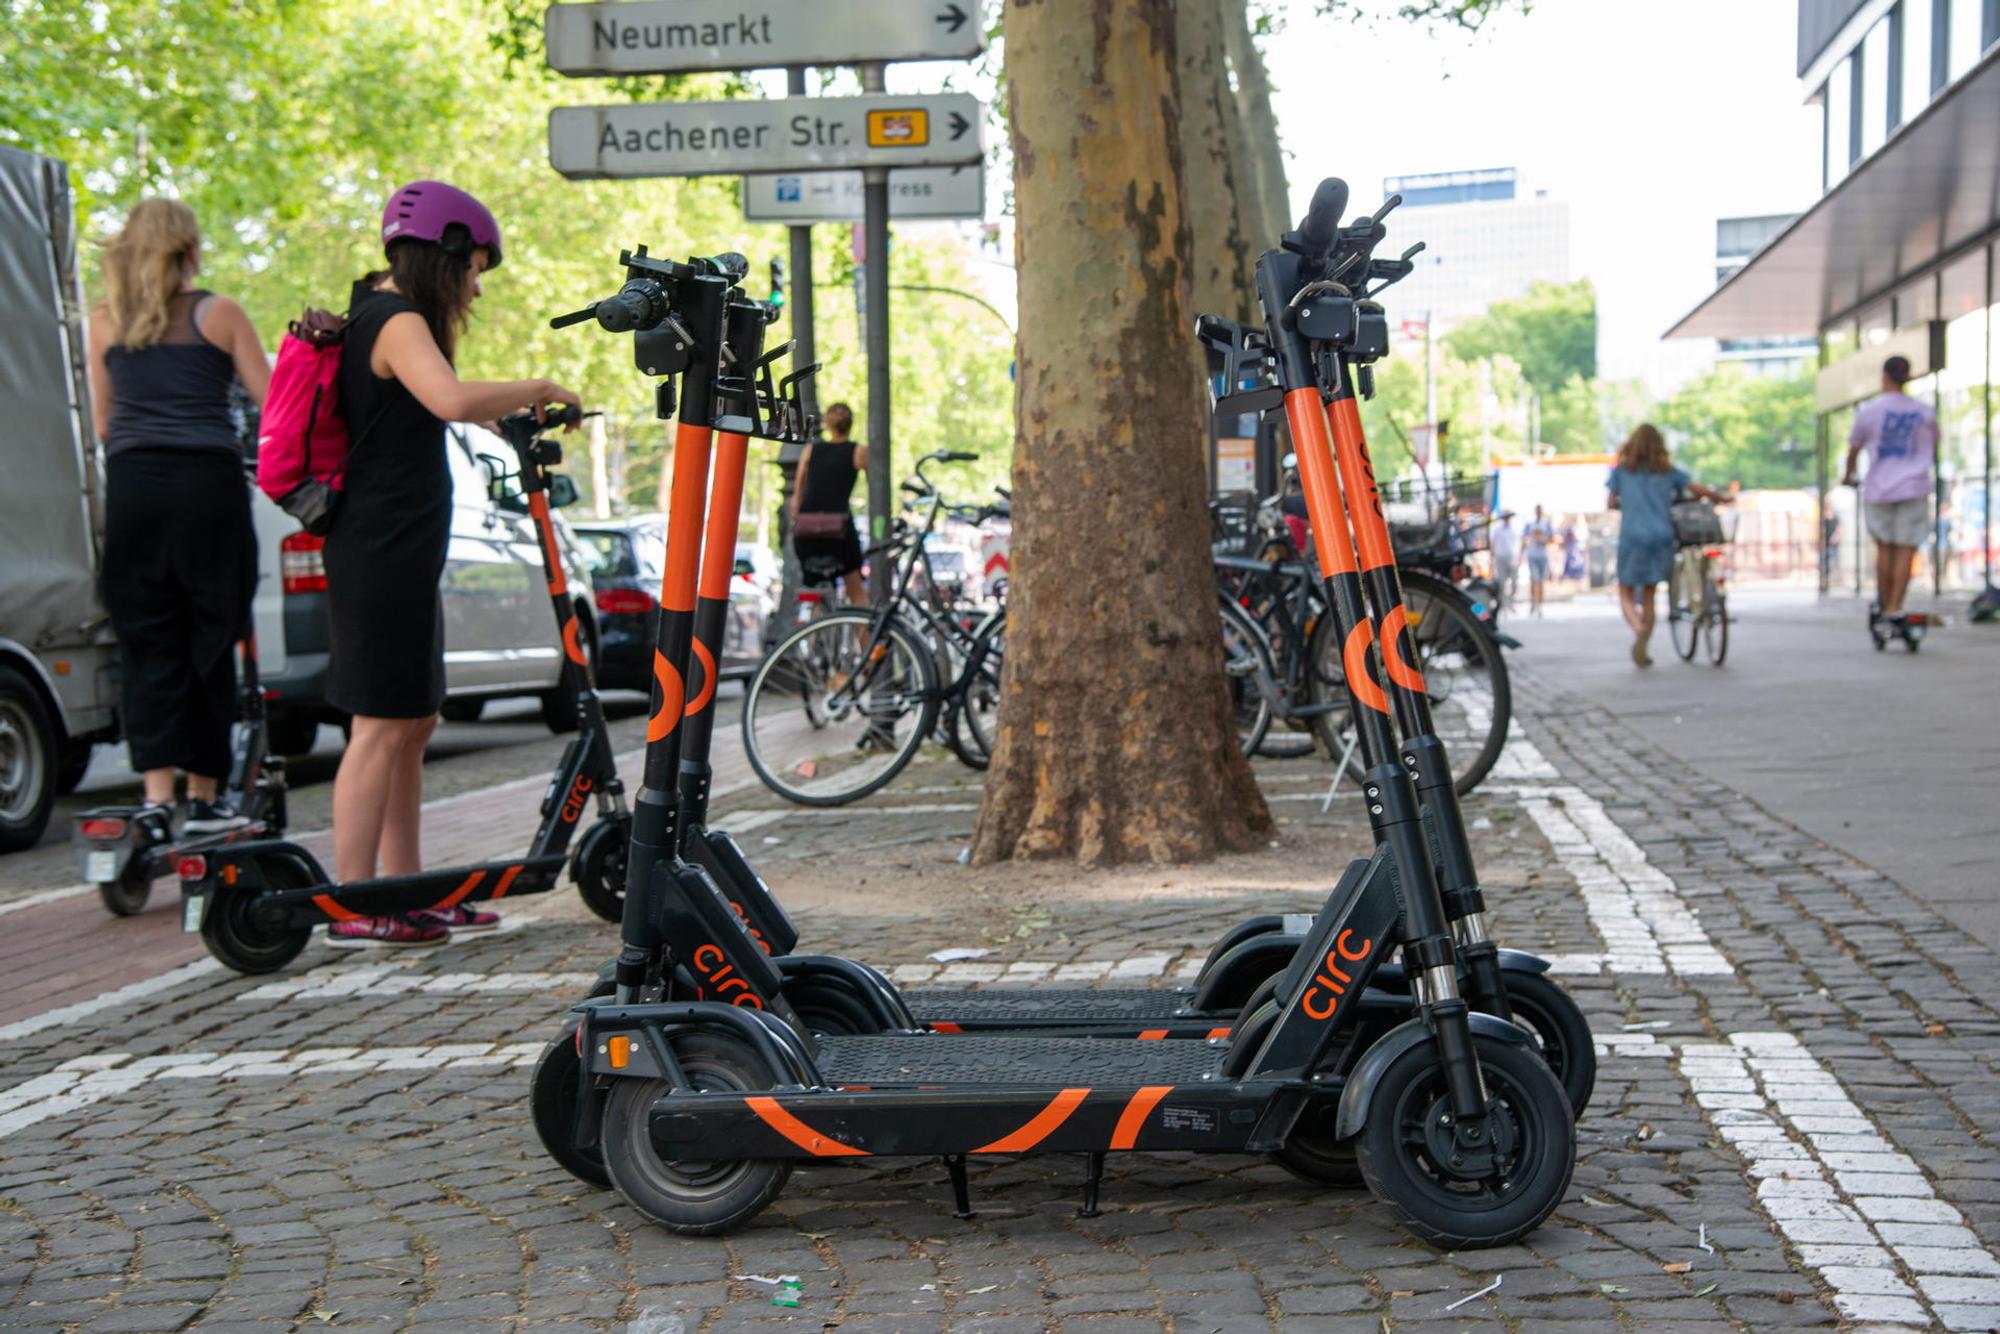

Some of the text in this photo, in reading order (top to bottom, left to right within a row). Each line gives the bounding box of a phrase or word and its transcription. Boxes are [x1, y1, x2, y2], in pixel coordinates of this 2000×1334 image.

[592, 14, 772, 52] Neumarkt
[599, 122, 770, 154] Aachener
[790, 115, 850, 148] Str.
[562, 774, 592, 823] circ
[1302, 928, 1372, 1021] circ
[1058, 1053, 1149, 1069] YOU
